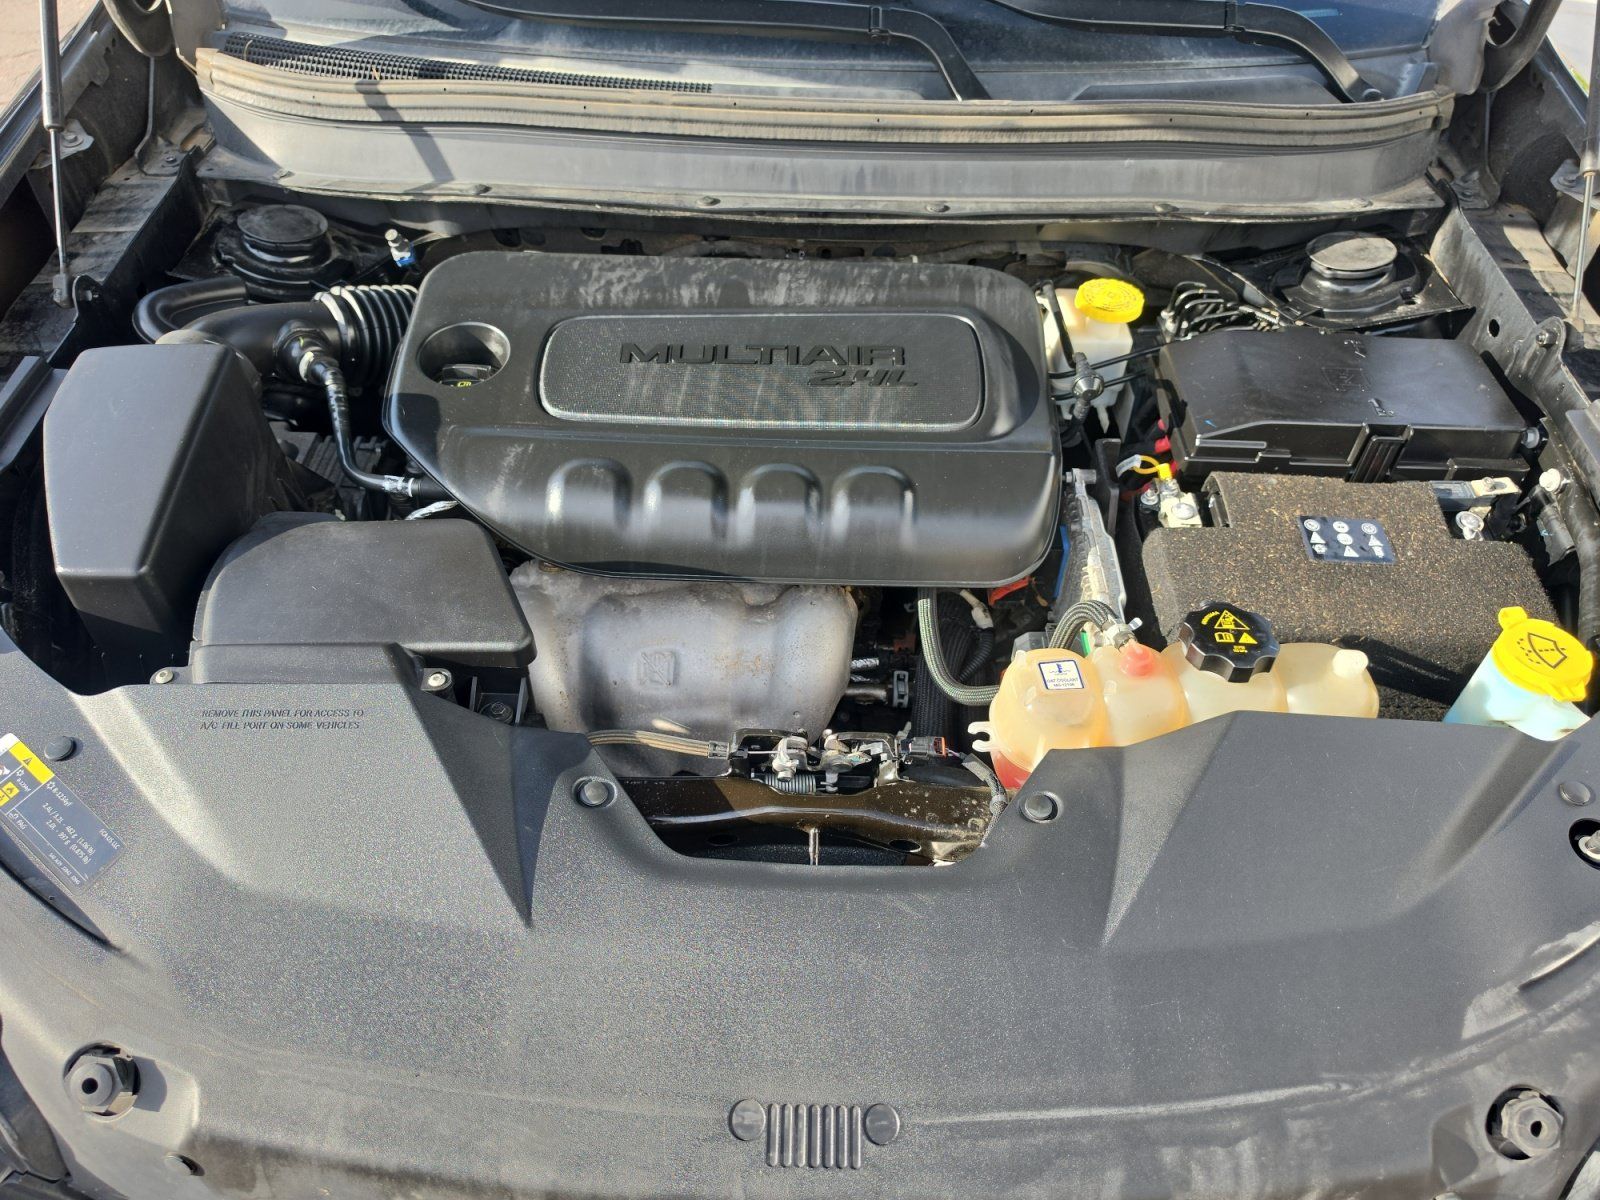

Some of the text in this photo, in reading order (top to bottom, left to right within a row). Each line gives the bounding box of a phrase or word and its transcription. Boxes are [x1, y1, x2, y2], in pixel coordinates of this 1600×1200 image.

[619, 342, 907, 366] MULTIAIR
[807, 369, 919, 387] 2.4L
[202, 709, 363, 717] REMOVE THIS PANEL FOR ACCESS TO
[200, 721, 217, 729] A/C
[221, 721, 240, 729] FILL
[243, 721, 267, 729] PORT
